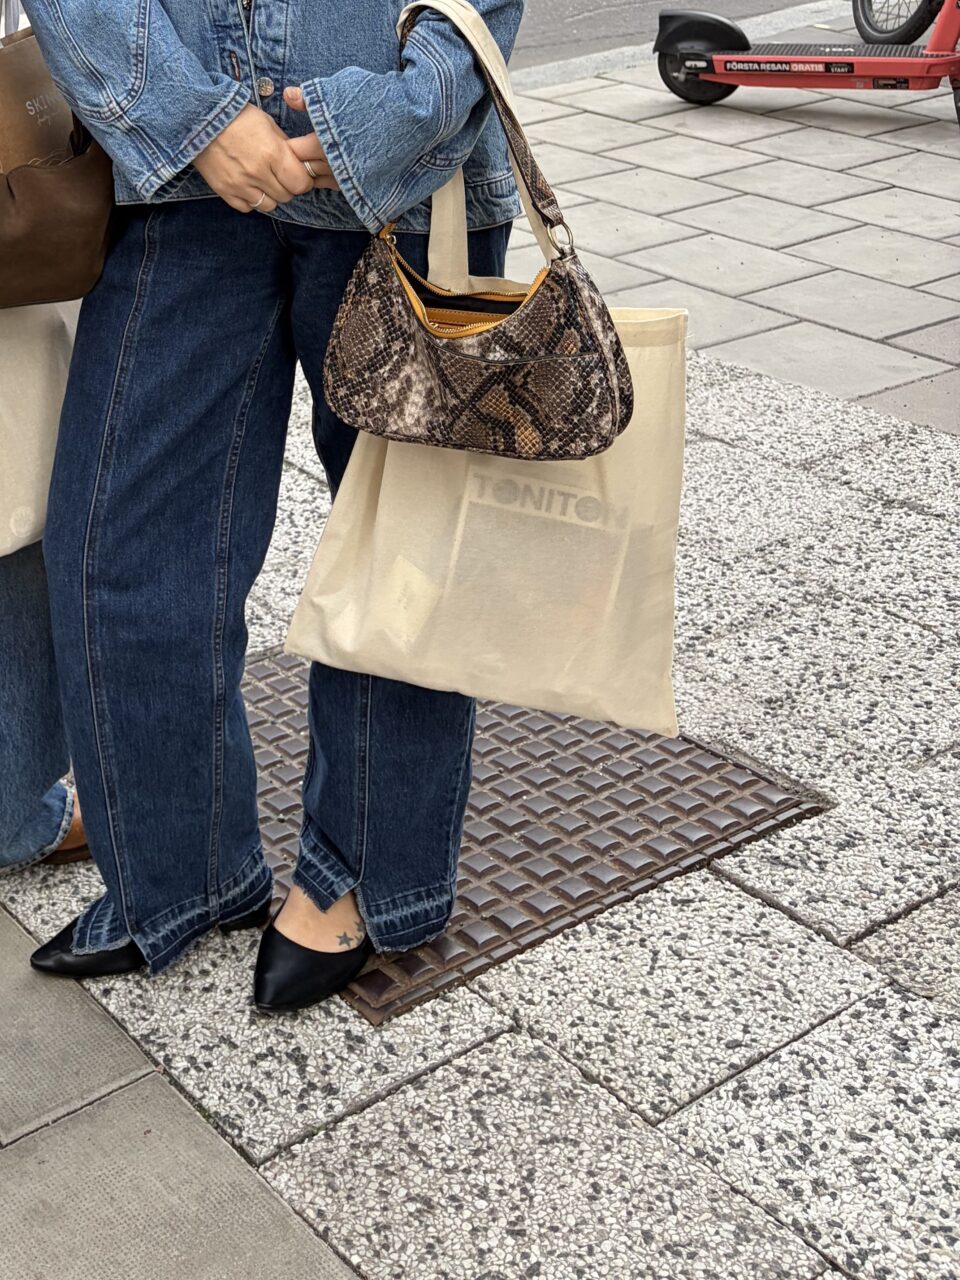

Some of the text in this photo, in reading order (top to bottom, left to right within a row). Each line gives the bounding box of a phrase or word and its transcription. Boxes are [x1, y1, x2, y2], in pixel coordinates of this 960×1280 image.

[726, 61, 760, 71] FÖRSTA
[760, 62, 790, 71] RESAN
[791, 63, 825, 72] GRATIS
